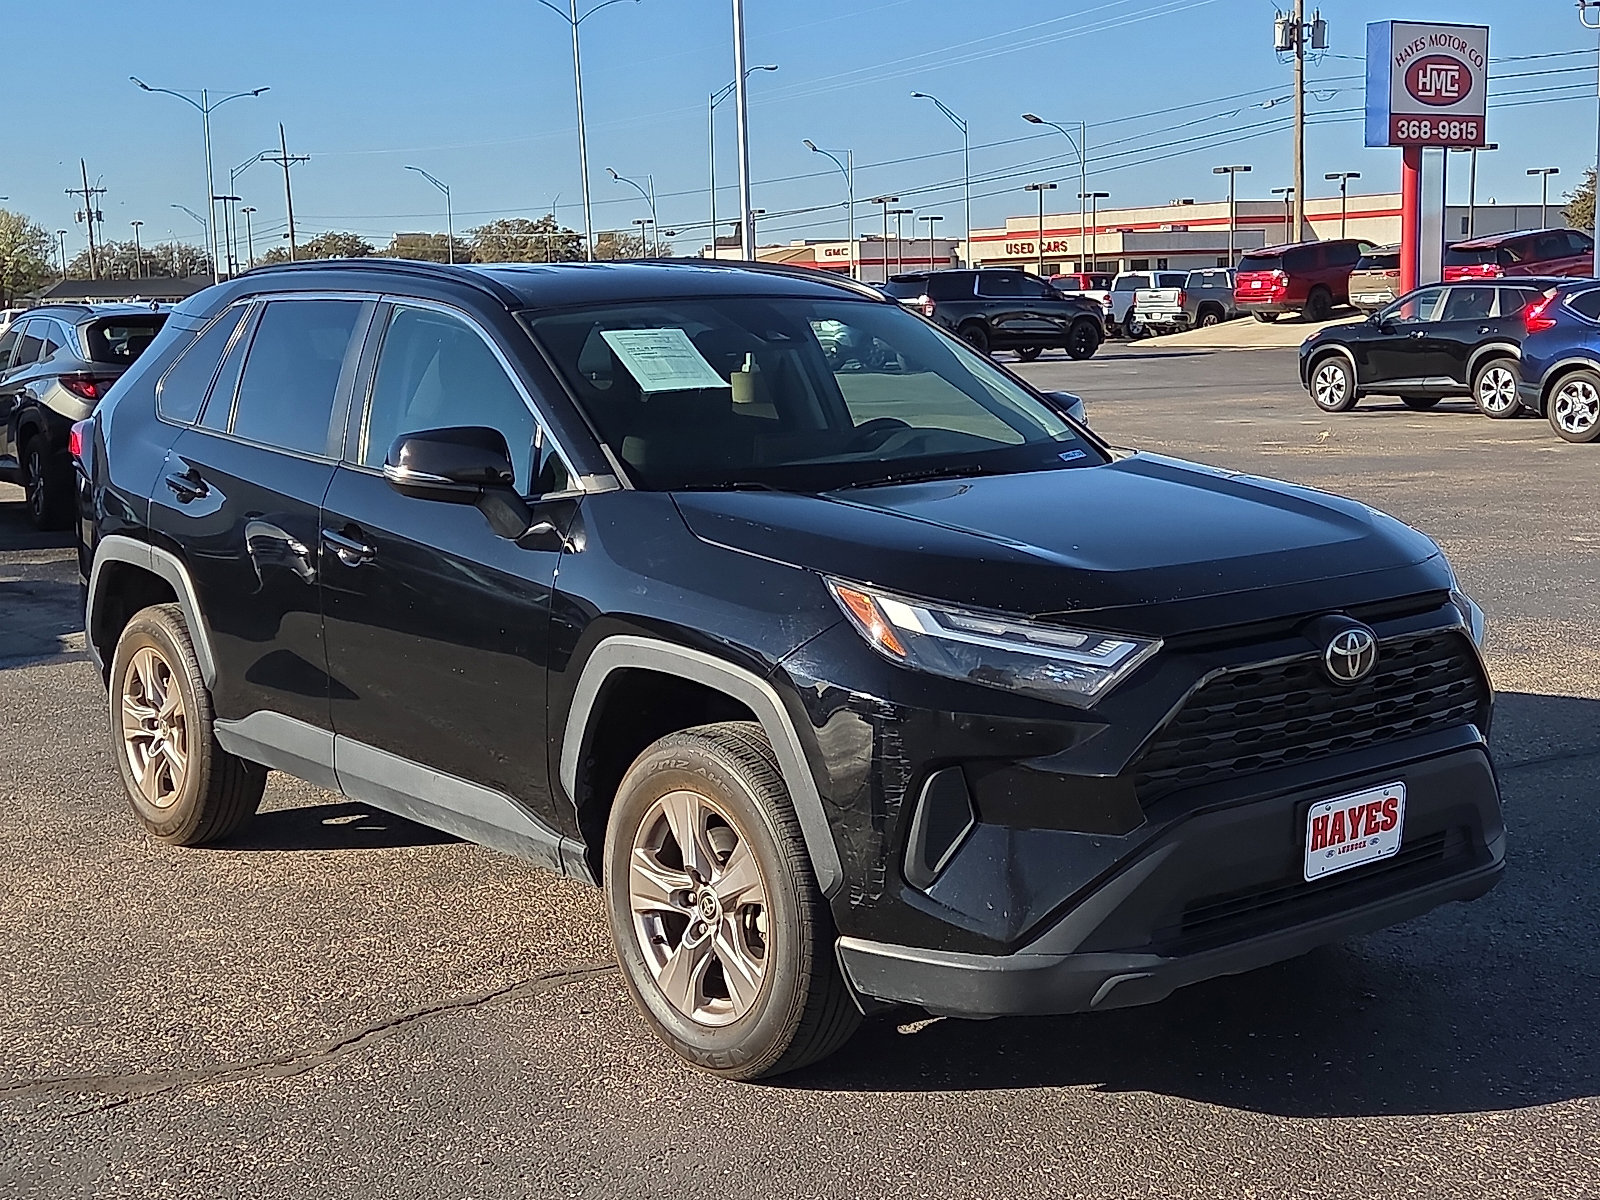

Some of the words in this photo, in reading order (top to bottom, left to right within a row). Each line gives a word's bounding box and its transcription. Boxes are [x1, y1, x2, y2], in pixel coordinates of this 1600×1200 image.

[1395, 36, 1426, 67] HAYES
[1428, 33, 1468, 54] MOTOR
[1468, 48, 1484, 71] CO.
[1417, 64, 1460, 97] HMC
[1397, 120, 1477, 140] 368-9815
[824, 247, 849, 257] GMC
[1006, 242, 1035, 255] USED
[1040, 240, 1068, 253] CARS
[1310, 798, 1399, 852] HAYES
